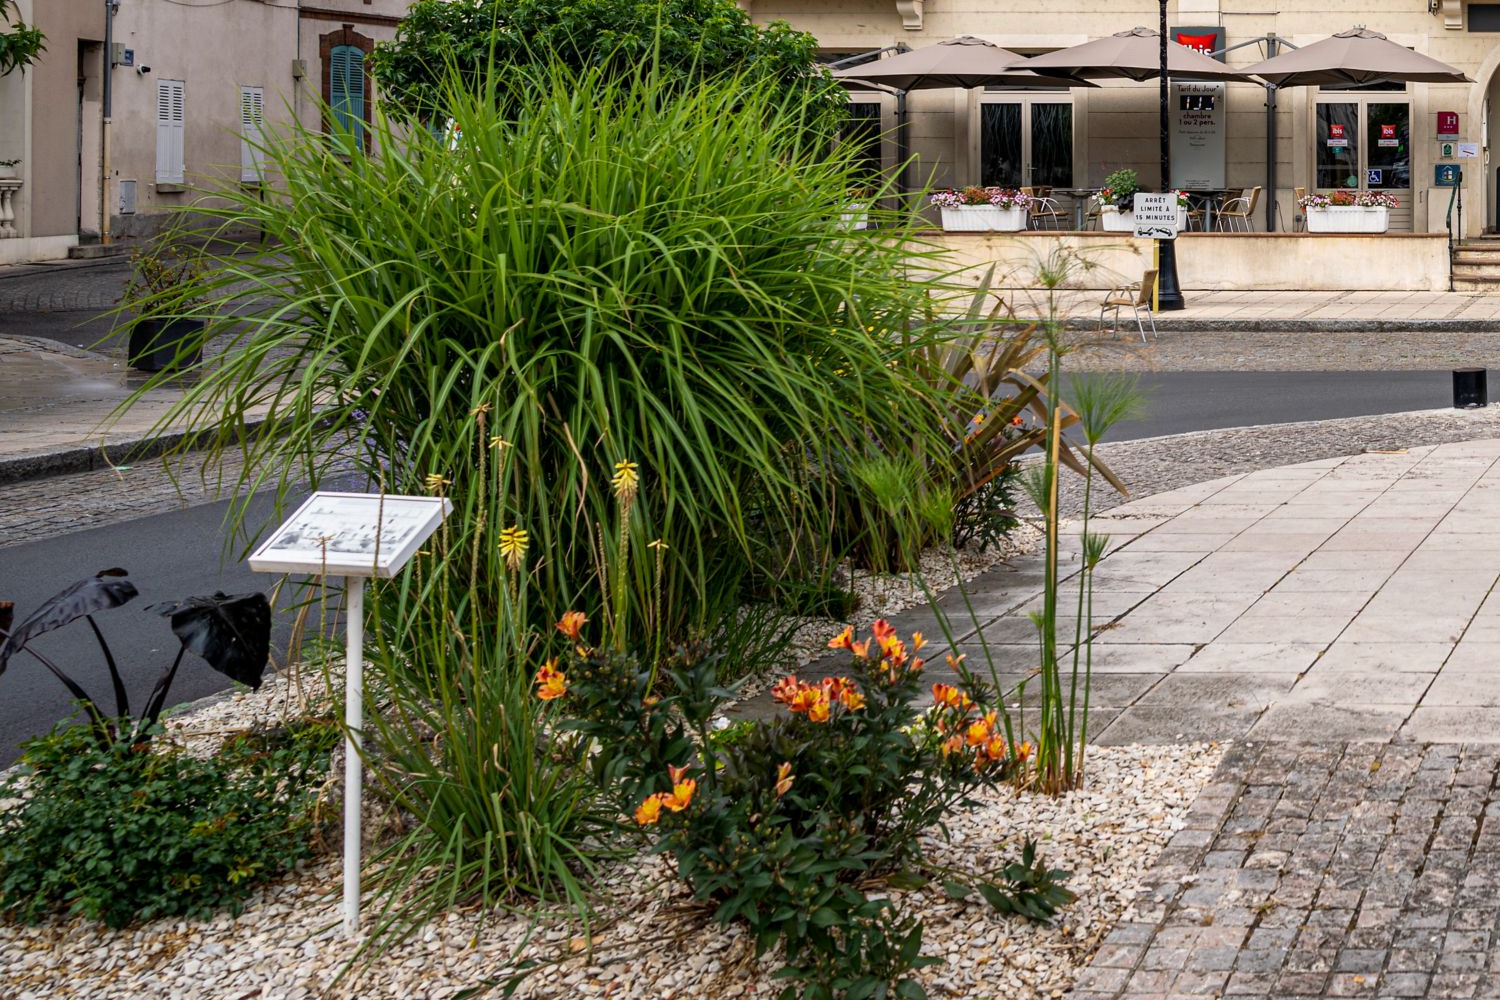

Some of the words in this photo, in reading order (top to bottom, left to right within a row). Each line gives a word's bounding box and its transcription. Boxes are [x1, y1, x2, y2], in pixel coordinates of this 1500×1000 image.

[1177, 84, 1192, 92] Tarif
[1192, 84, 1201, 92] du
[1447, 116, 1456, 125] H
